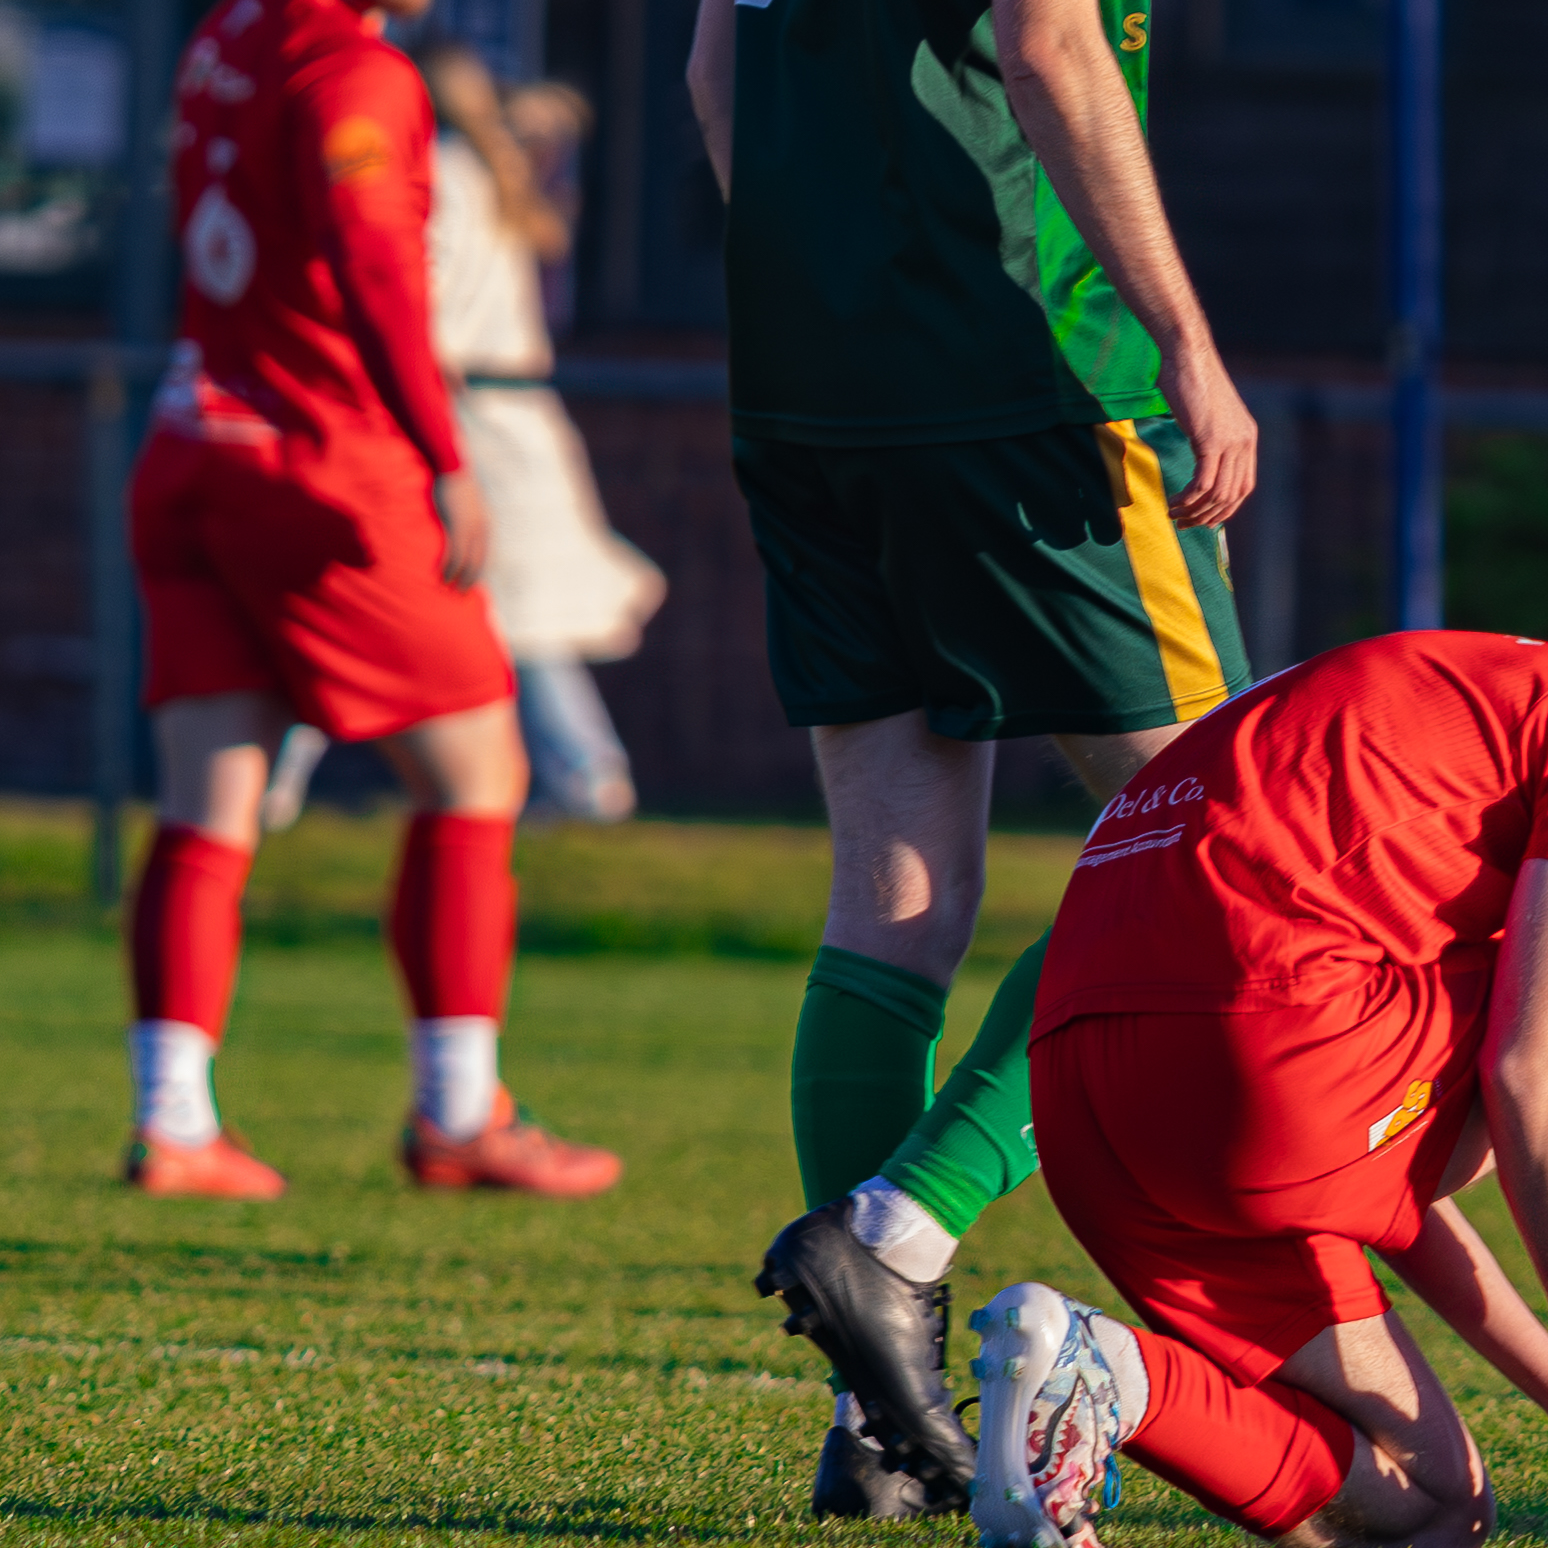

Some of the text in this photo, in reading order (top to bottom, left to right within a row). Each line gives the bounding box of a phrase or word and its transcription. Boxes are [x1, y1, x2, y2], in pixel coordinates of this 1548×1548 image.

[184, 186, 258, 308] 6
[1141, 784, 1167, 814] &
[1167, 777, 1204, 806] Co.
